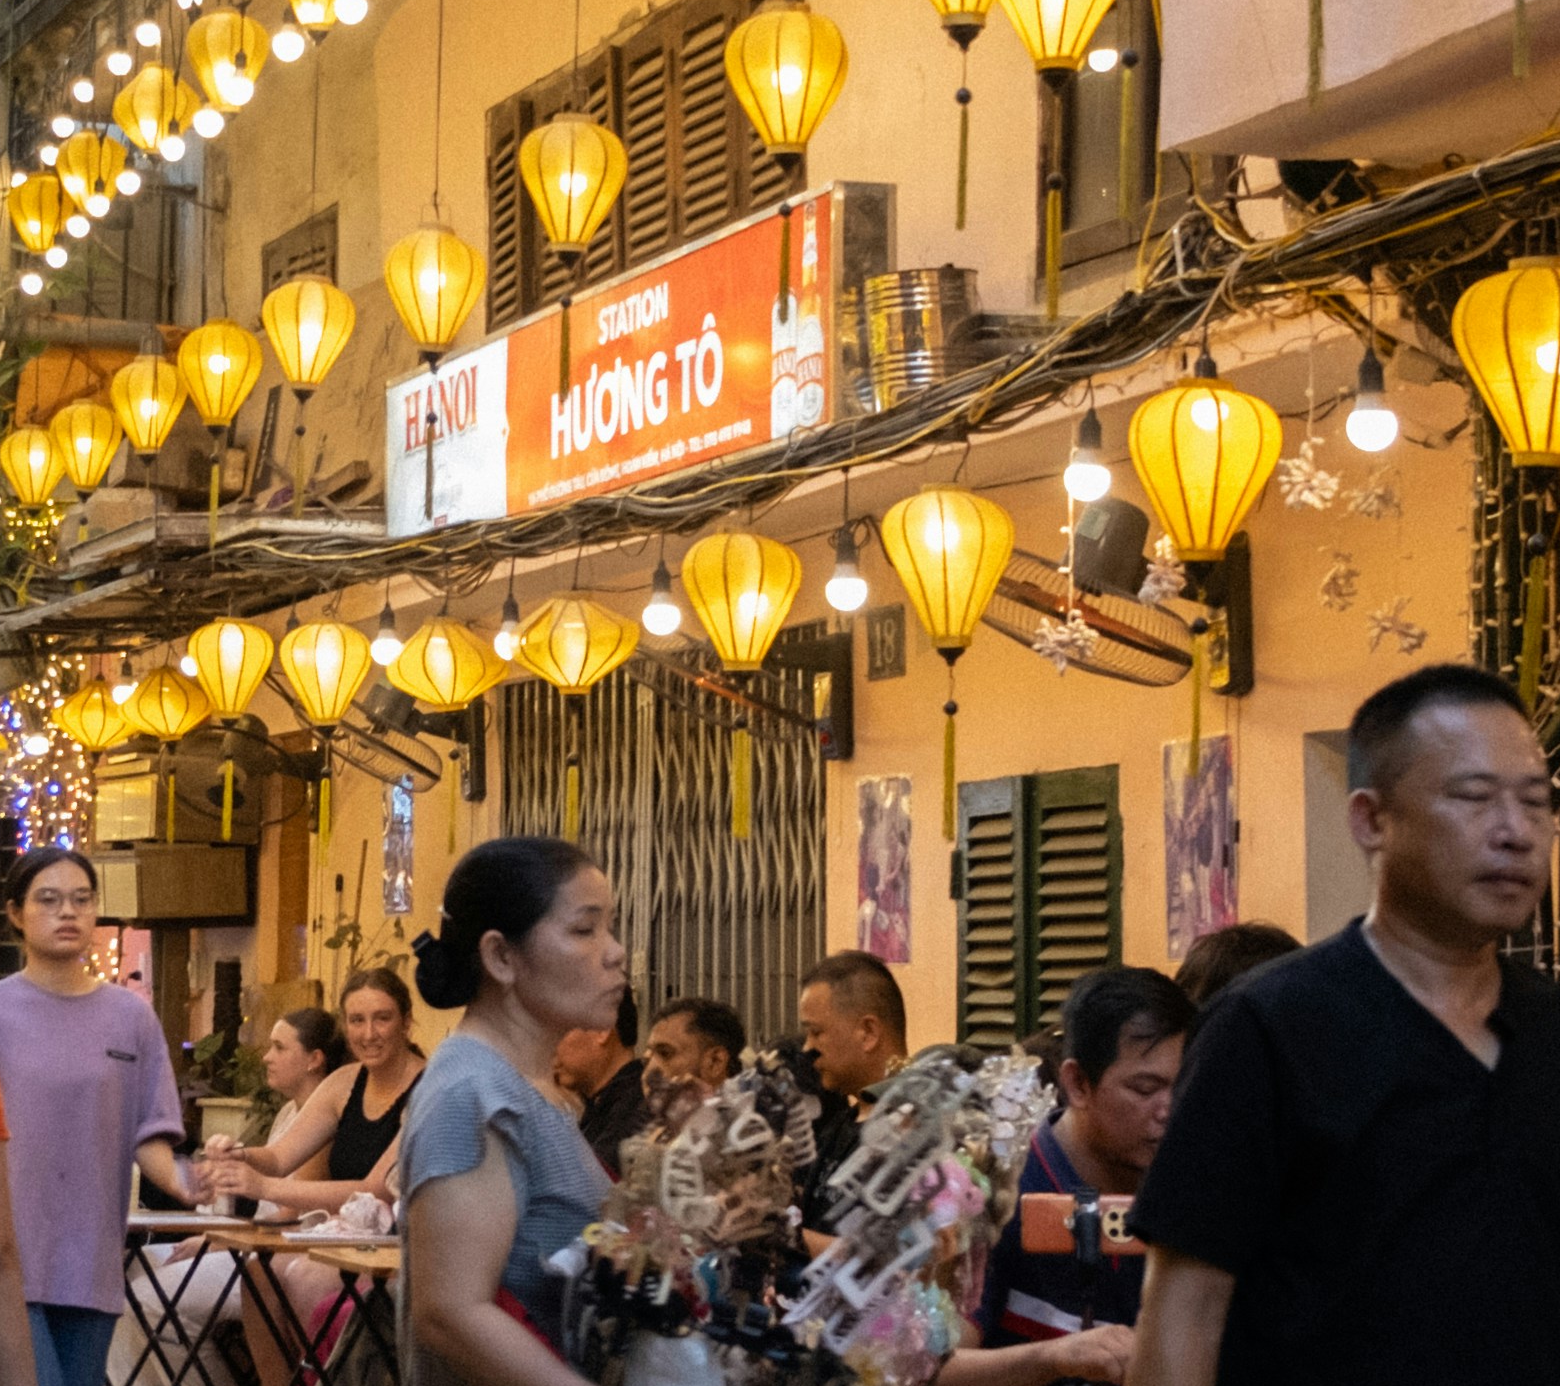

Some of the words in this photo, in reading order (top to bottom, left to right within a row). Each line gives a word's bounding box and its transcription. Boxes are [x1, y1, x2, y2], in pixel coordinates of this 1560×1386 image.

[598, 282, 669, 346] STATION
[404, 365, 479, 453] HANOI
[551, 352, 669, 460] HƯƠNG
[675, 312, 724, 414] TÔ
[875, 619, 896, 668] 18
